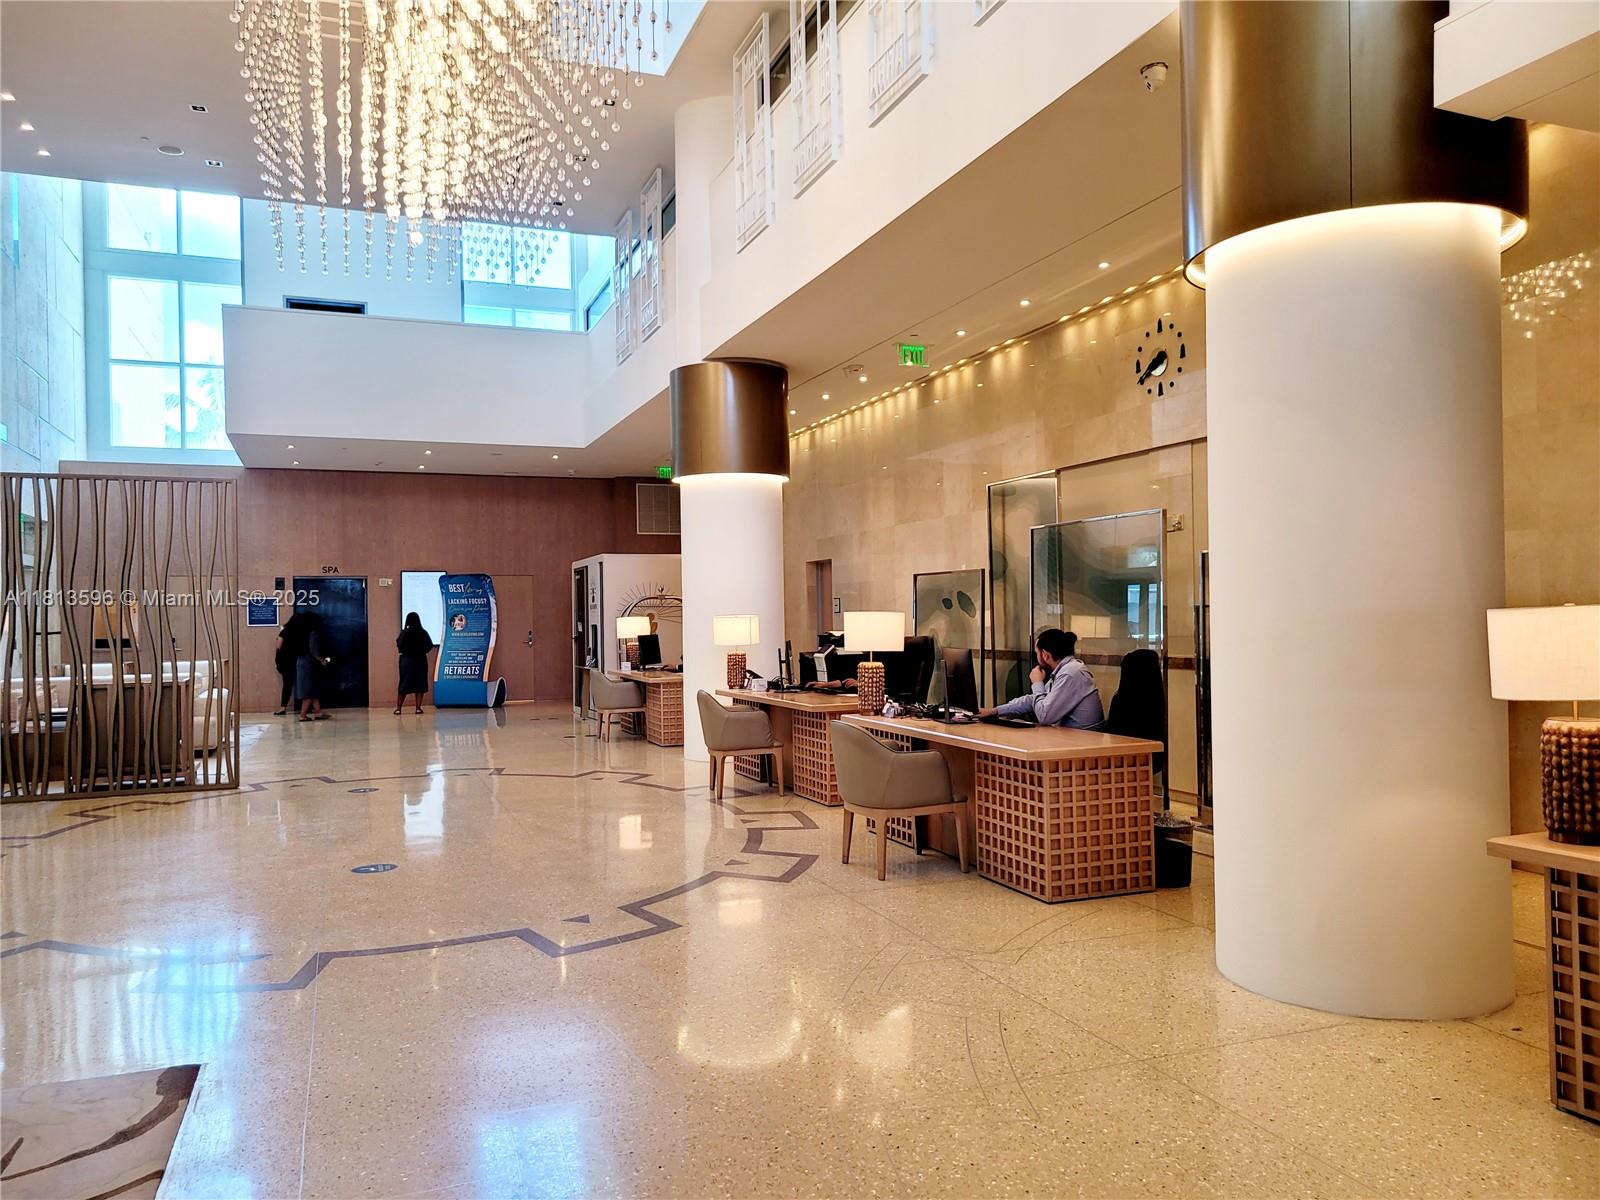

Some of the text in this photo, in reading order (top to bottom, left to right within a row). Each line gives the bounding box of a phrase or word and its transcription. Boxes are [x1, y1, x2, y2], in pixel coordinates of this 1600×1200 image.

[902, 345, 925, 365] EXIT
[321, 566, 340, 574] SPA
[448, 583, 465, 593] BEST
[443, 666, 480, 675] RETREATS
